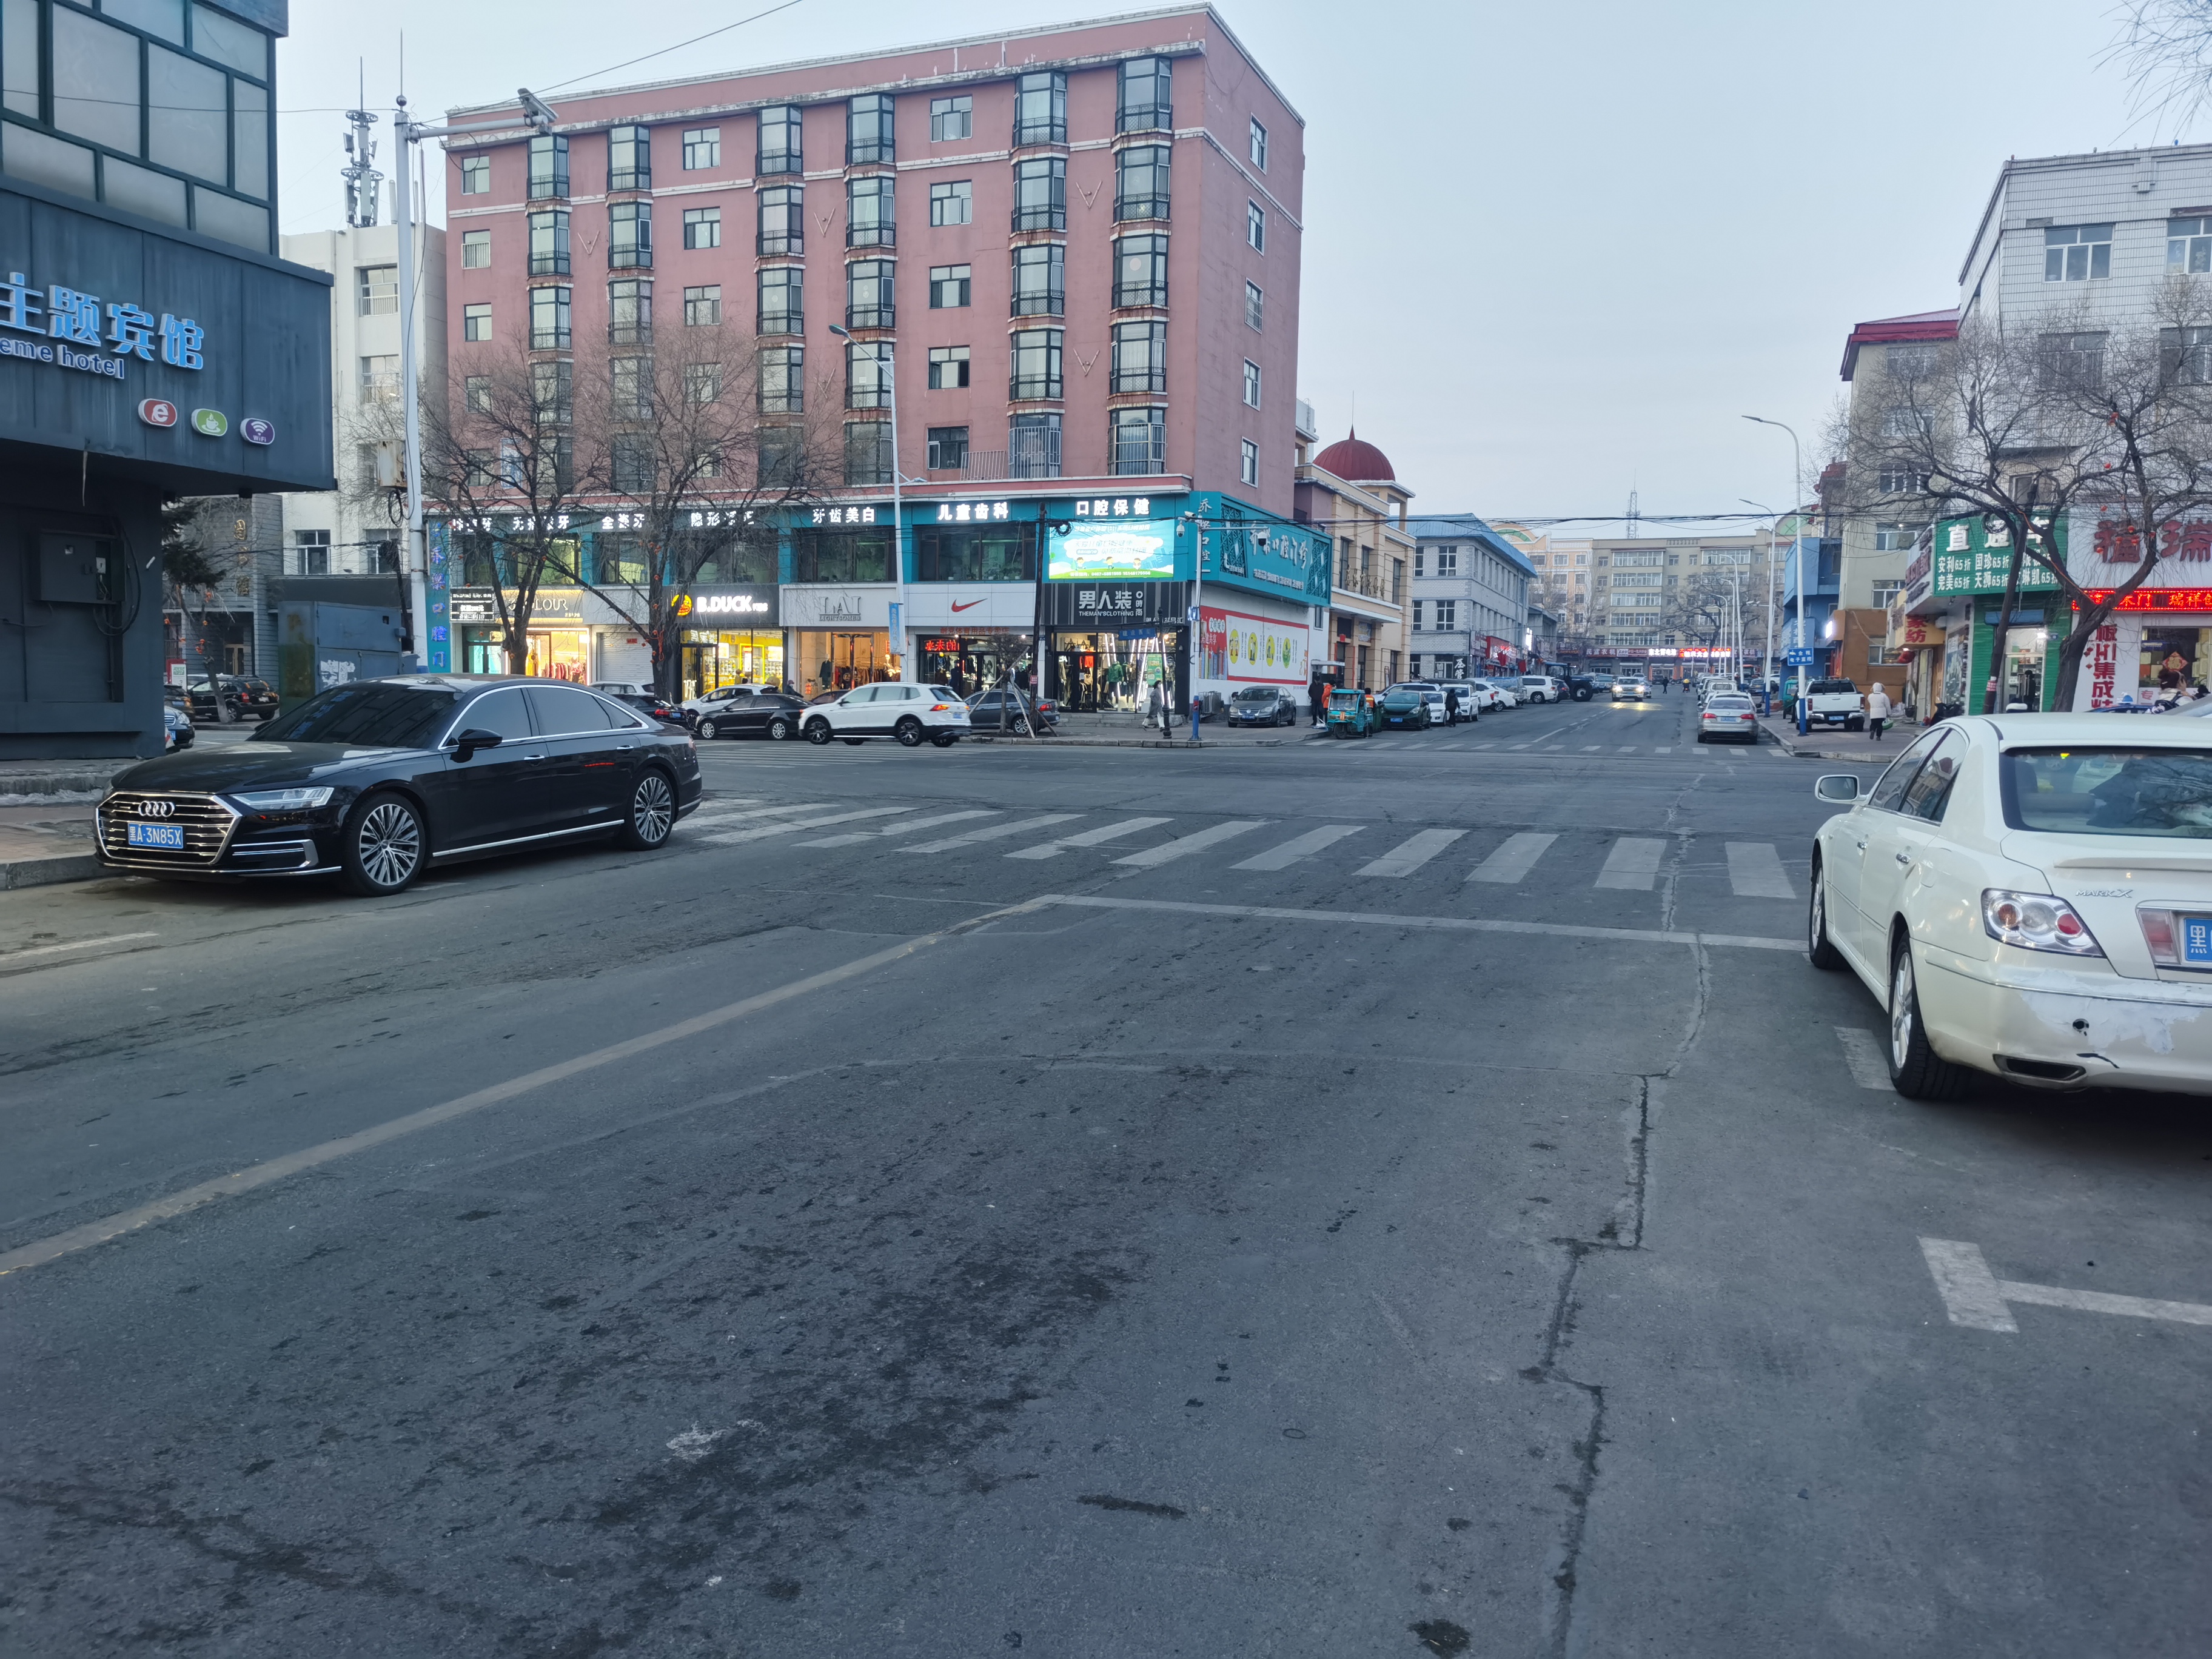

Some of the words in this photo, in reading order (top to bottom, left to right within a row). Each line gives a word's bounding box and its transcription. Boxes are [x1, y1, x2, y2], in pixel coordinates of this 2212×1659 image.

[0, 272, 204, 370] 主题宾馆
[57, 344, 125, 380] hotel
[252, 435, 267, 443] WiFi
[812, 506, 876, 523] 牙齿美白
[938, 501, 1009, 521] 儿童齿科
[1076, 498, 1150, 515] 口腔保健
[2016, 569, 2058, 586] 琳凯6.5折
[697, 595, 752, 612] B.DUCK
[819, 596, 861, 615] LAI
[1079, 591, 1132, 609] 男人装
[2190, 925, 2212, 954] 黑
